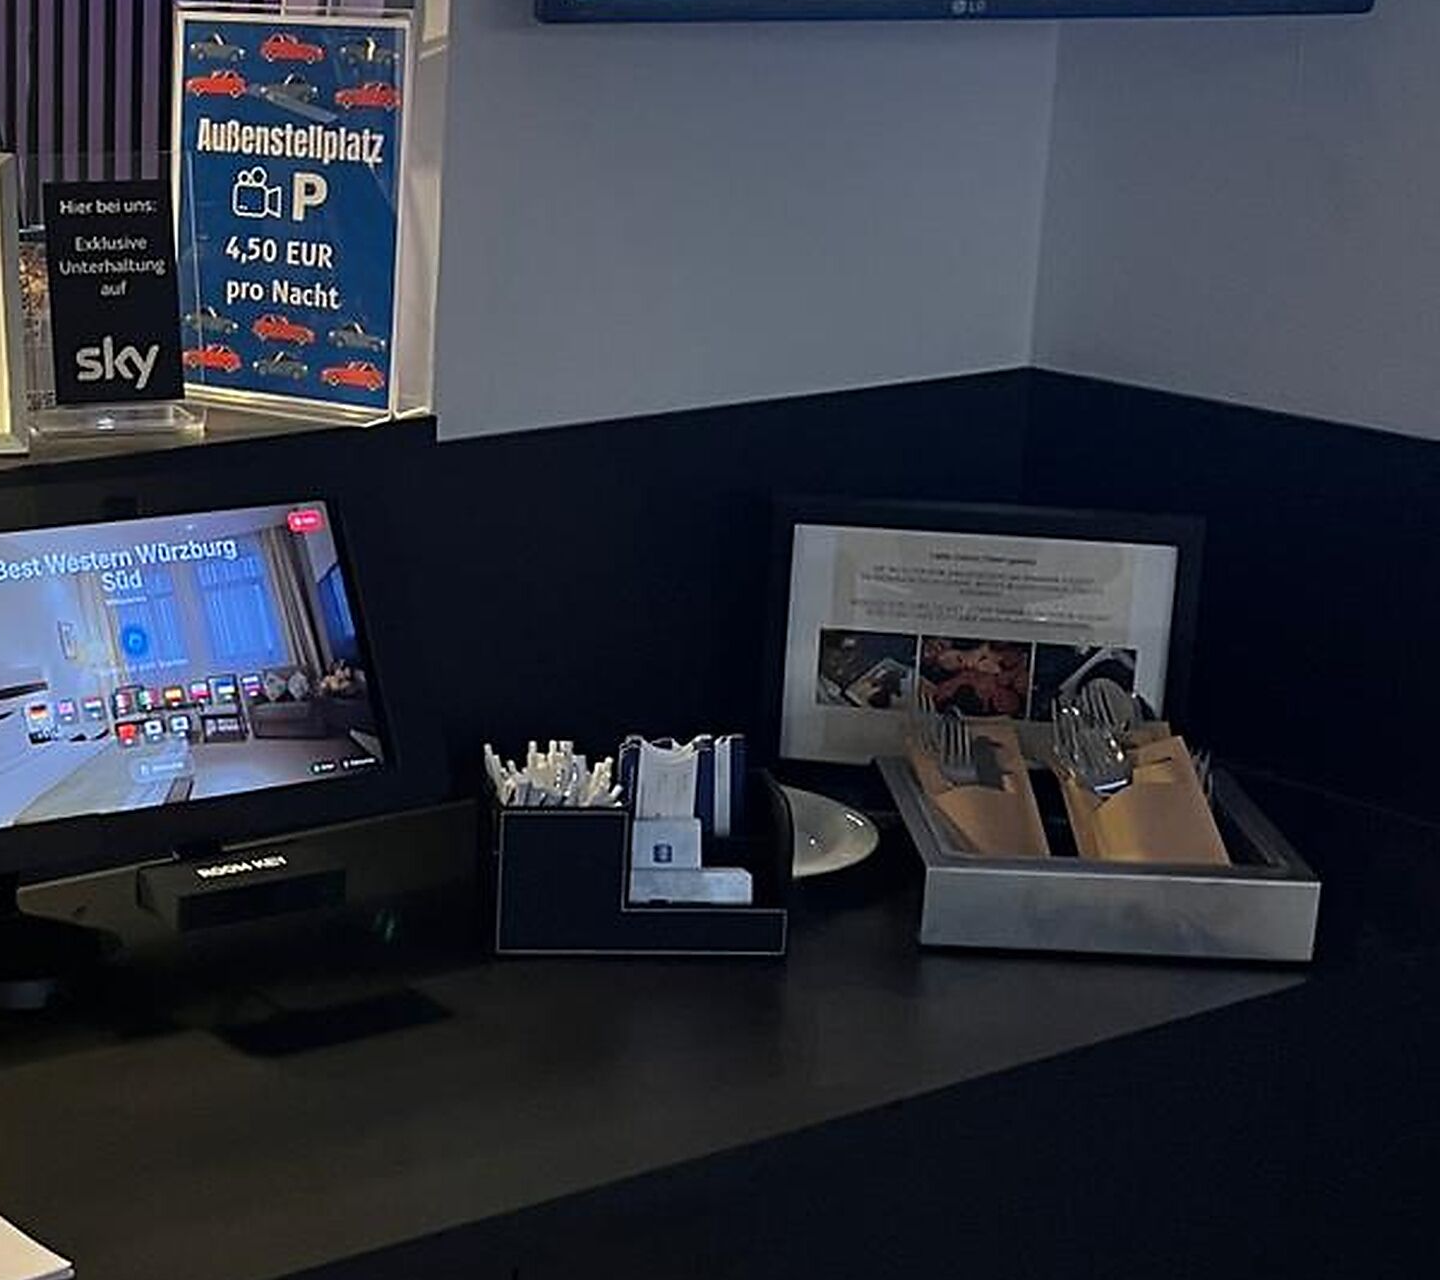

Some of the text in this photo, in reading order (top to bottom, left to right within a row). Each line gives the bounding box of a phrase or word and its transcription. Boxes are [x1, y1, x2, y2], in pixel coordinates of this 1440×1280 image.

[197, 117, 385, 165] Außenstellplatz
[59, 198, 158, 215] Hier bei uns:
[291, 172, 329, 221] P
[74, 235, 148, 252] Exklusive
[225, 235, 334, 270] 4,50 EUR
[59, 257, 166, 277] Unterhaltung
[99, 280, 128, 297] auf
[226, 279, 343, 310] pro Nacht
[75, 334, 160, 390] sky
[43, 549, 134, 576] Western
[134, 536, 239, 566] Würzburg
[101, 568, 144, 594] Süd
